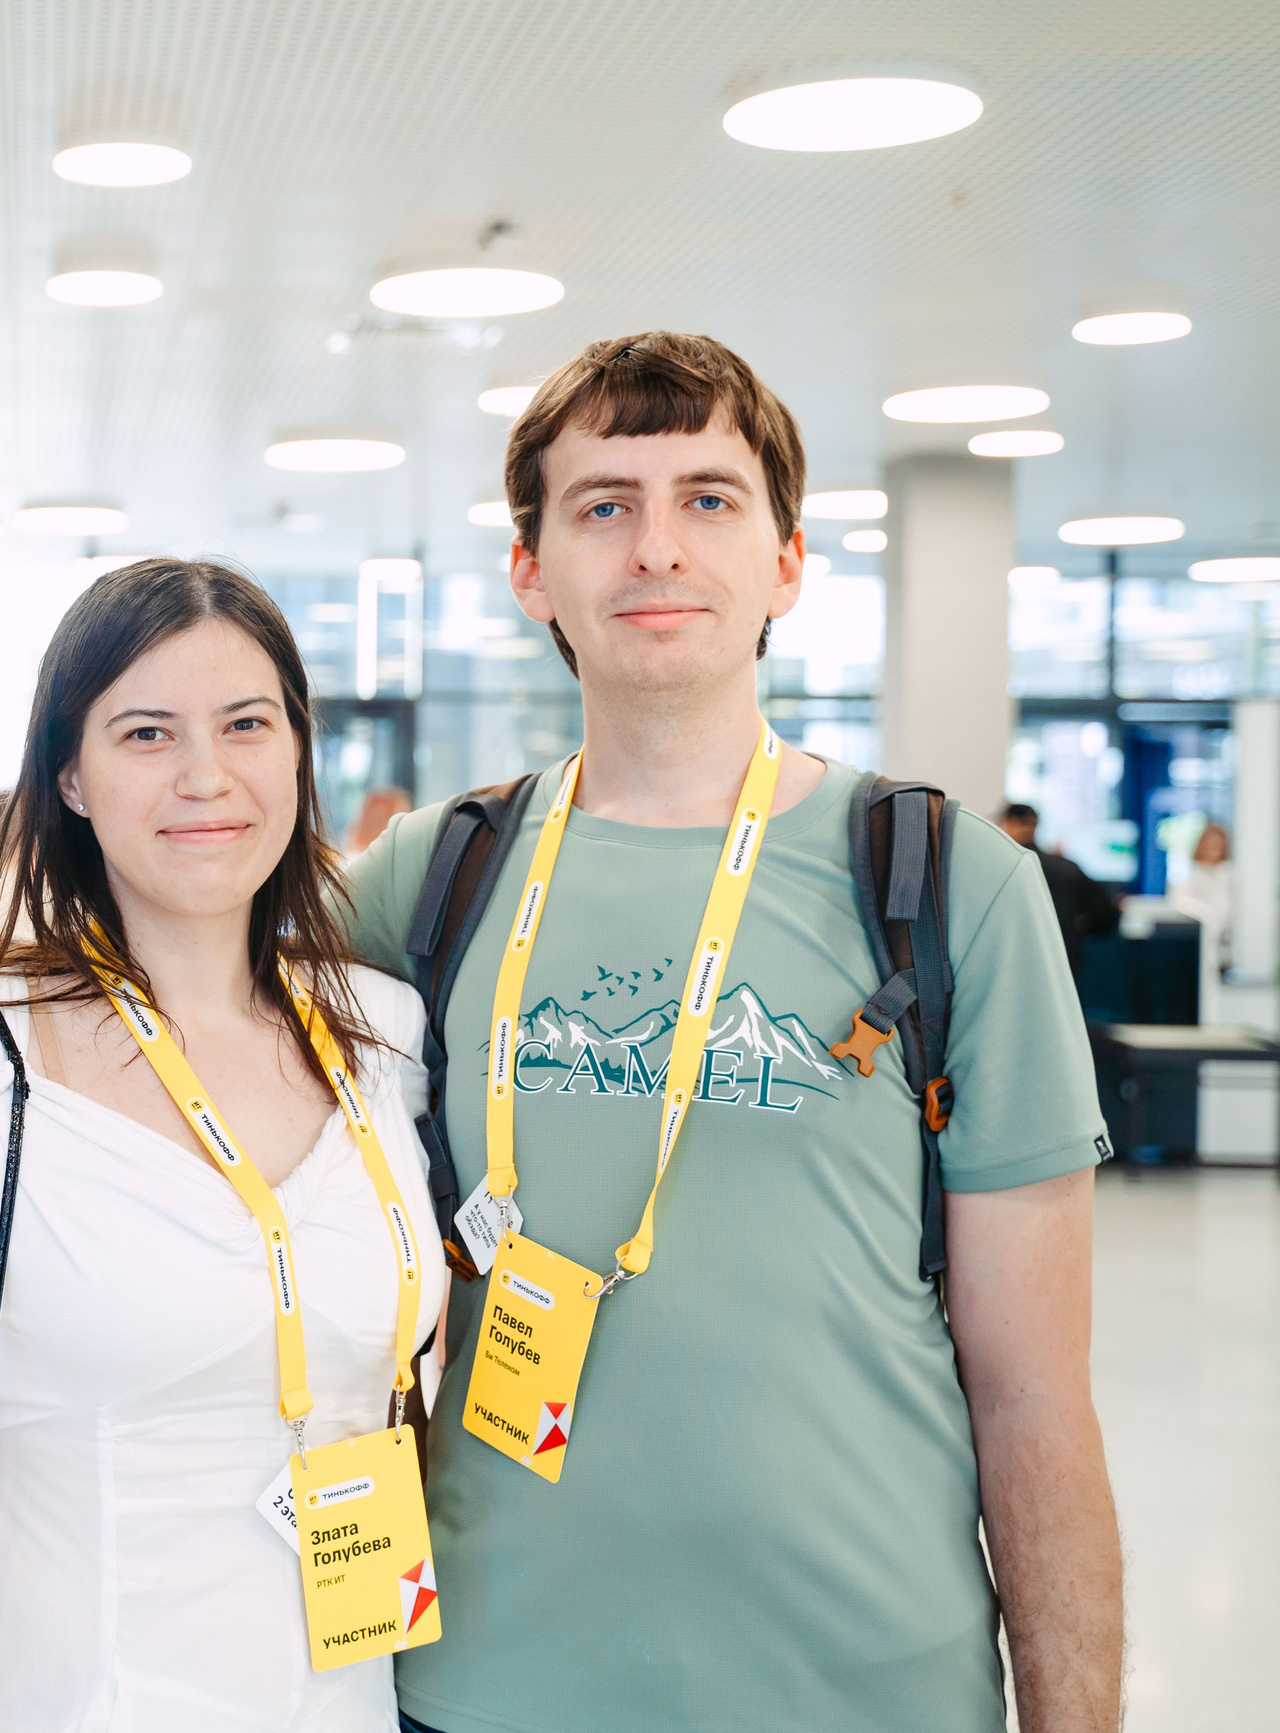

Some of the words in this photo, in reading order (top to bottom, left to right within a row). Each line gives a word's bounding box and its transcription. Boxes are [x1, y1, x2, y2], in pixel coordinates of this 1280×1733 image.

[733, 824, 752, 871] ТИНЬКОФФ
[695, 956, 714, 1011] ТИНЬКОФФ
[122, 988, 153, 1036] ТНЬКОФФ
[498, 1022, 507, 1079] ТИНЬКОФФ
[513, 1038, 803, 1113] CAMEL
[201, 1114, 235, 1162] ТИНЬКОФФ
[393, 1207, 412, 1264] ТИНЬКОФФ
[277, 1247, 290, 1309] ТИНЬКОФФ
[512, 1280, 550, 1305] ТИНЬКОФФ
[493, 1305, 533, 1338] Павел
[485, 1350, 493, 1361] Би
[493, 1355, 520, 1376] Телеком
[489, 1324, 541, 1366] Голубев
[474, 1402, 530, 1445] УЧАСТНИК
[322, 1482, 370, 1500] ТИНЬКОФФ
[273, 1495, 285, 1508] 2
[280, 1503, 299, 1531] эта
[310, 1522, 359, 1546] Злата
[313, 1536, 392, 1568] Голубева
[317, 1576, 333, 1589] РТК
[334, 1574, 346, 1586] ИТ
[323, 1619, 397, 1650] УЧАСТНИК
